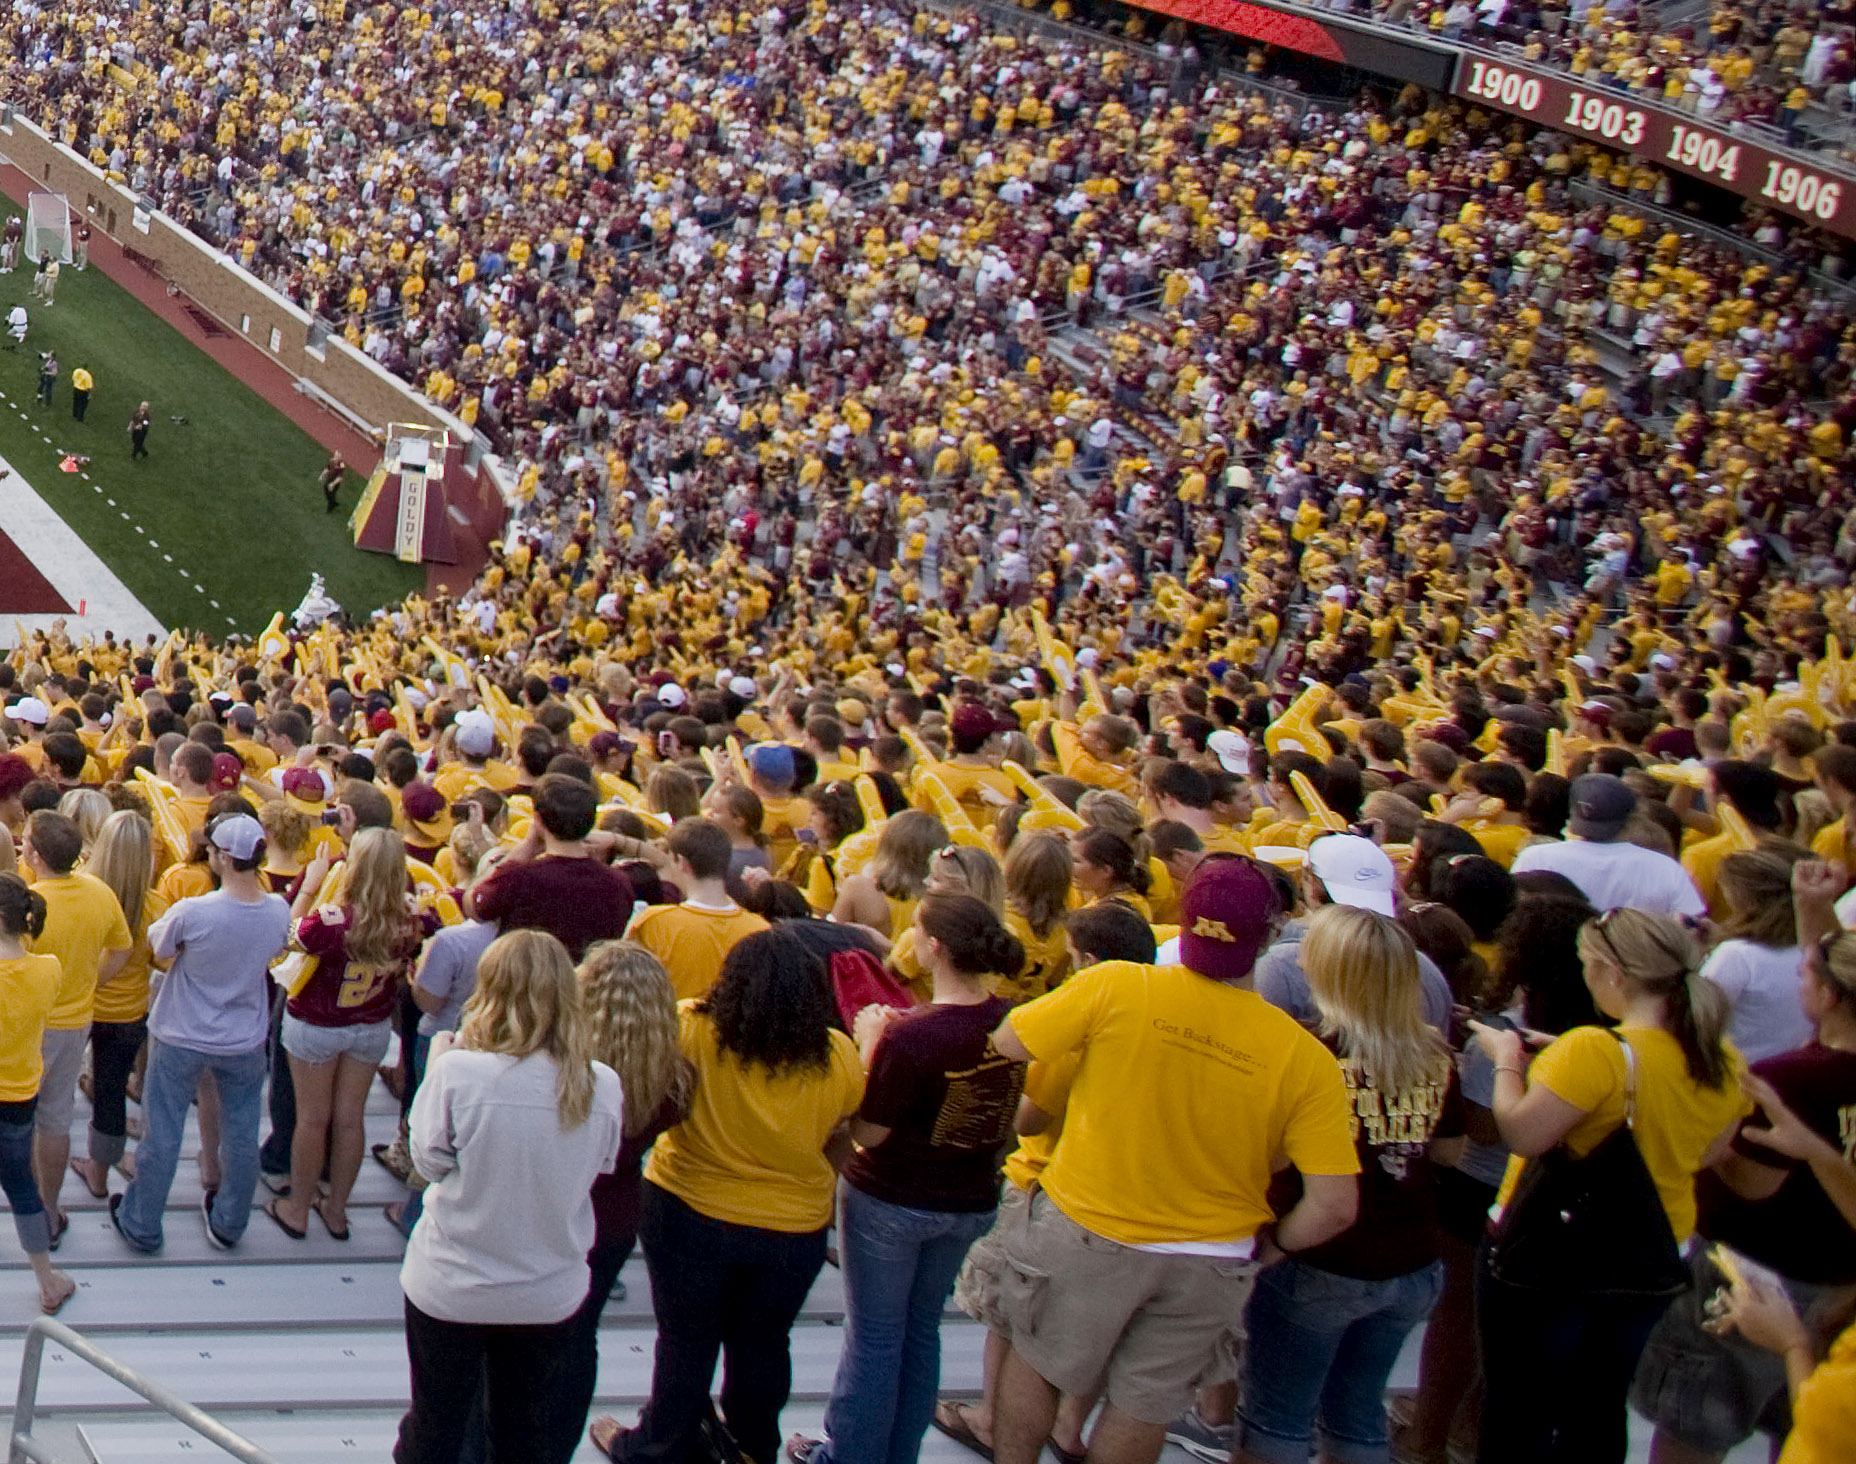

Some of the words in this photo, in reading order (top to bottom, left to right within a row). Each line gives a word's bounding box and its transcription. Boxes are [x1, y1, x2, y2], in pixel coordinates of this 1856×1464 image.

[1466, 61, 1544, 112] 1900
[1563, 92, 1648, 145] 1903
[1666, 125, 1743, 182] 1904
[1760, 160, 1844, 220] 1906
[406, 482, 417, 546] GOLDY
[1191, 915, 1237, 943] M
[1153, 1018, 1179, 1035] Get
